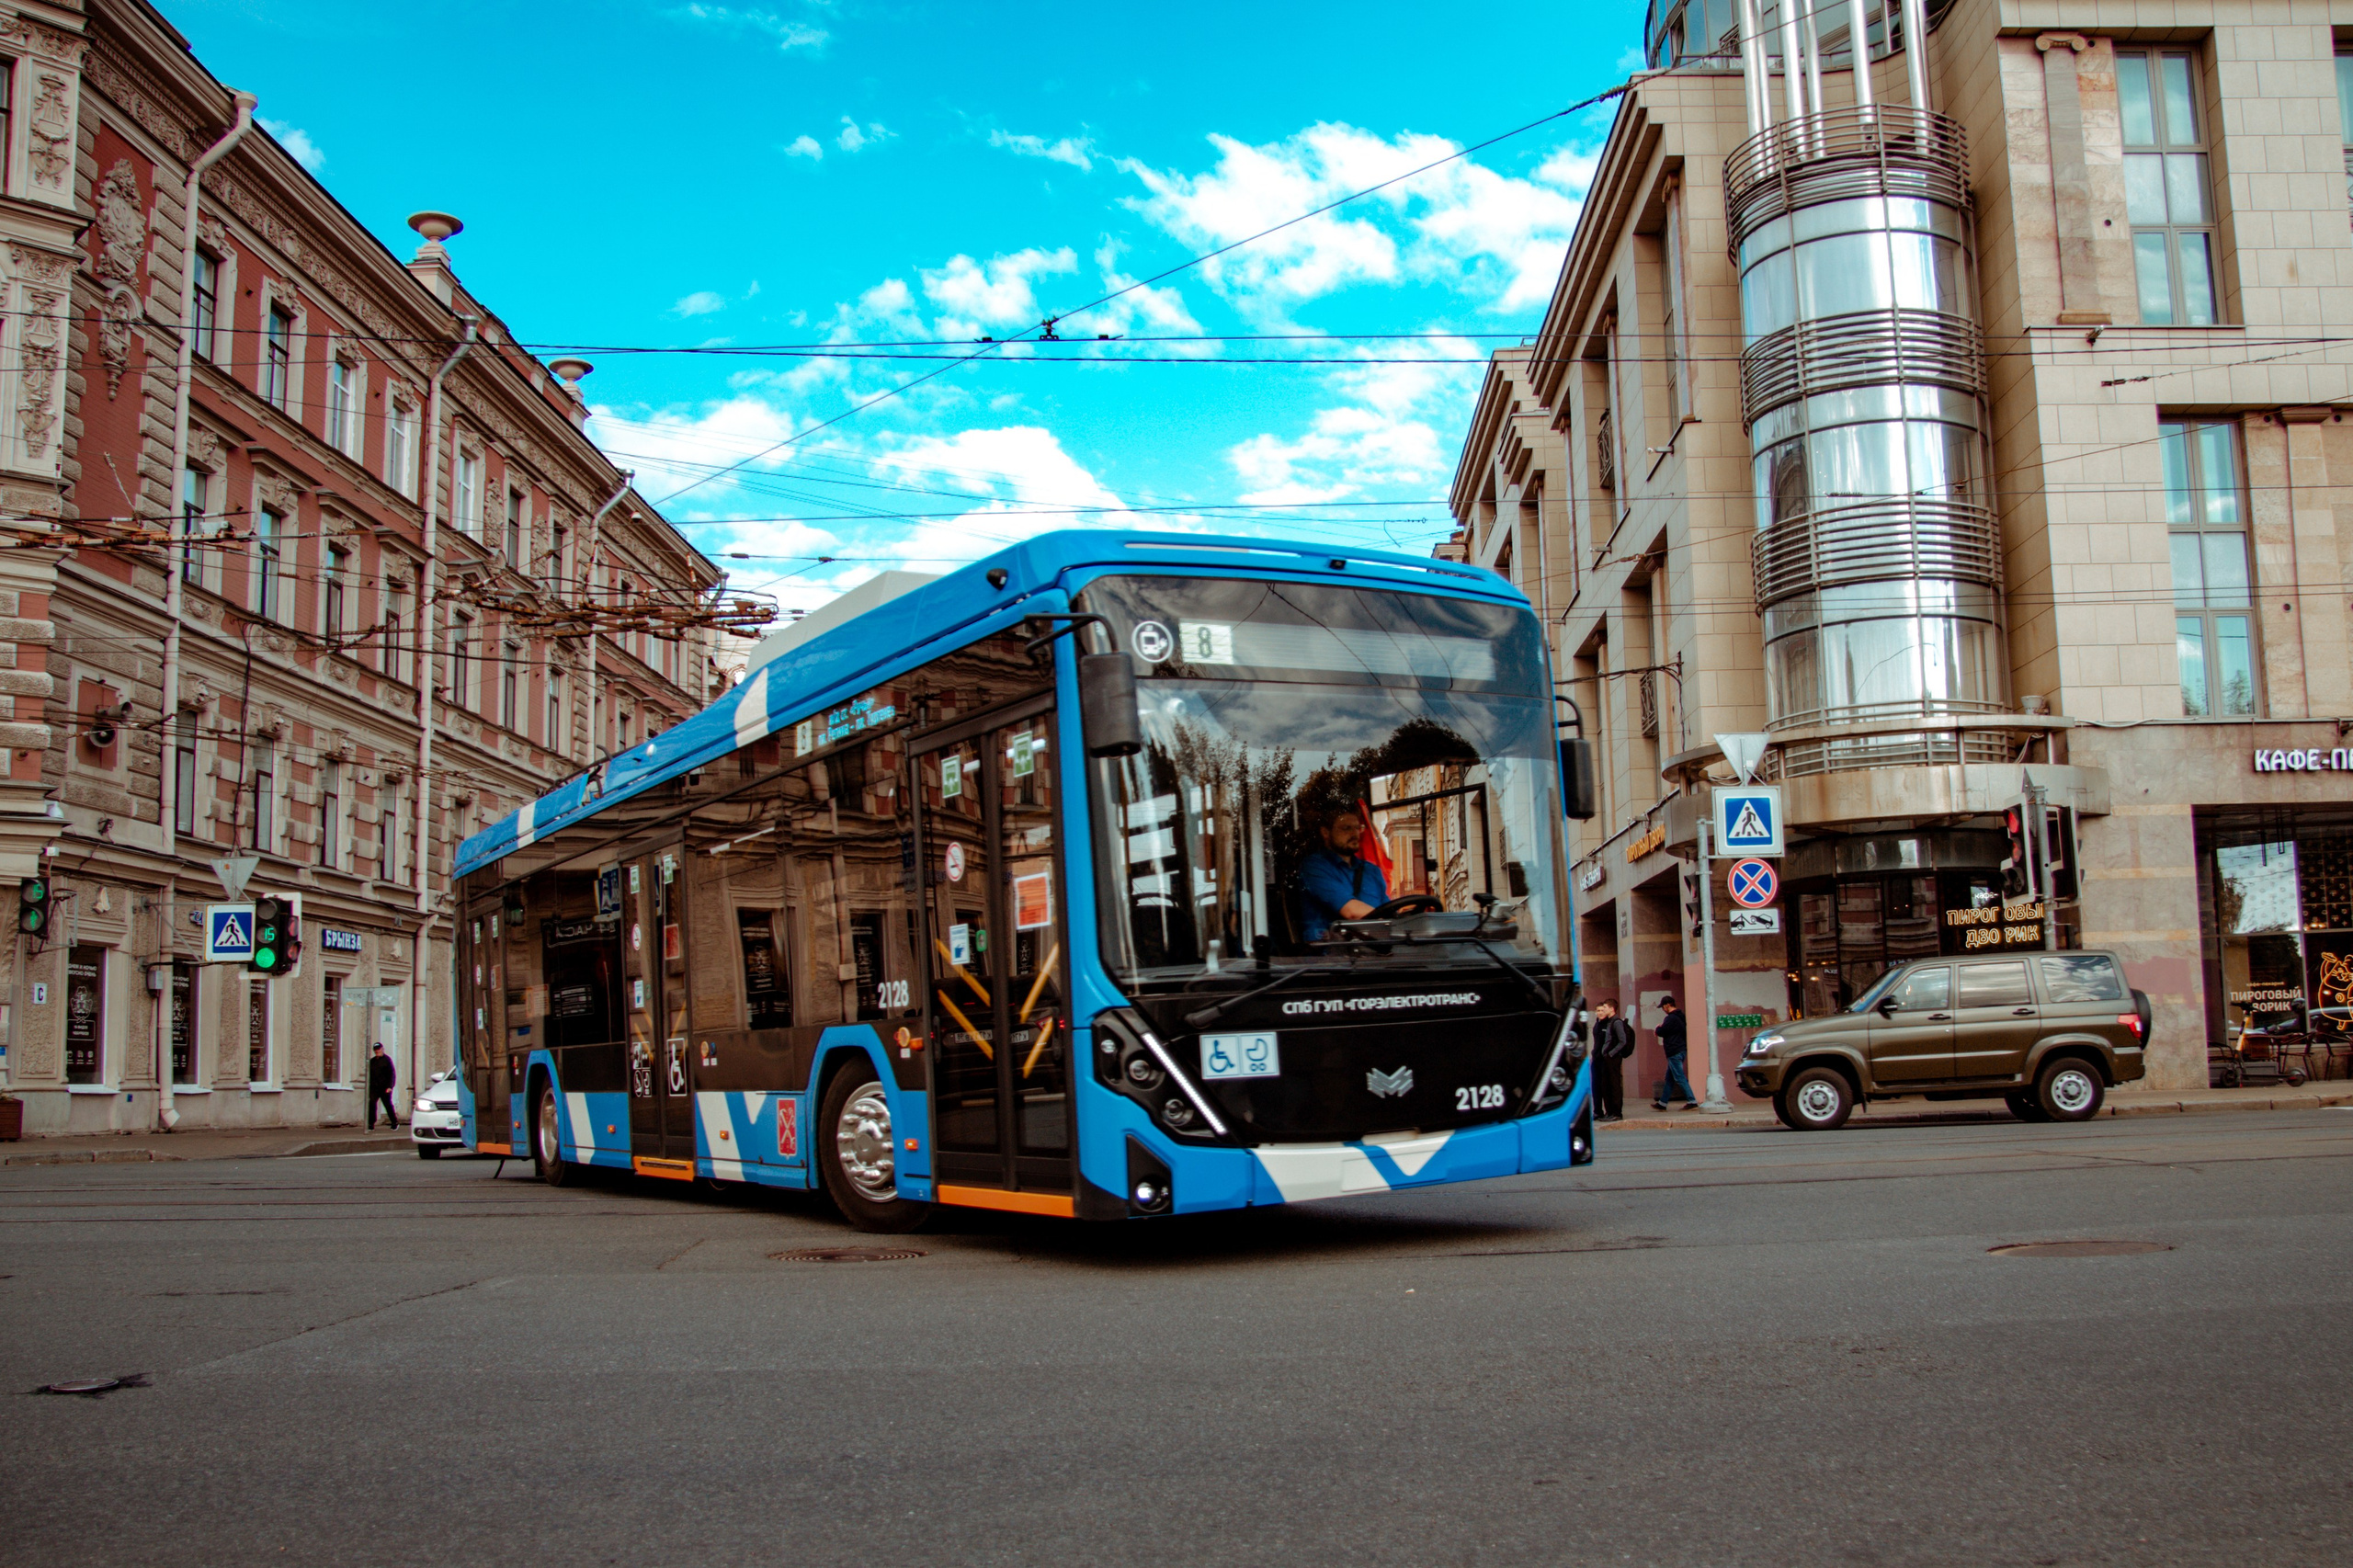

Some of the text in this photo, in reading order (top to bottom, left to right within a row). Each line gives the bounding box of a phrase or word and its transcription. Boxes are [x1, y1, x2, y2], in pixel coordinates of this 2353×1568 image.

[1198, 627, 1213, 658] 8
[801, 725, 807, 749] 8
[32, 883, 43, 899] 15
[264, 927, 275, 941] 15
[325, 929, 362, 949] БРЫНЗА
[878, 980, 909, 1009] 2128
[1314, 999, 1344, 1013] ГУП
[1344, 992, 1482, 1010] «ГОРЭЛЕКТРОТРАНС»
[2230, 986, 2302, 1002] ПИРОГОВЫЙ
[2252, 1001, 2291, 1013] ВОРИК
[1455, 1084, 1506, 1110] 2128
